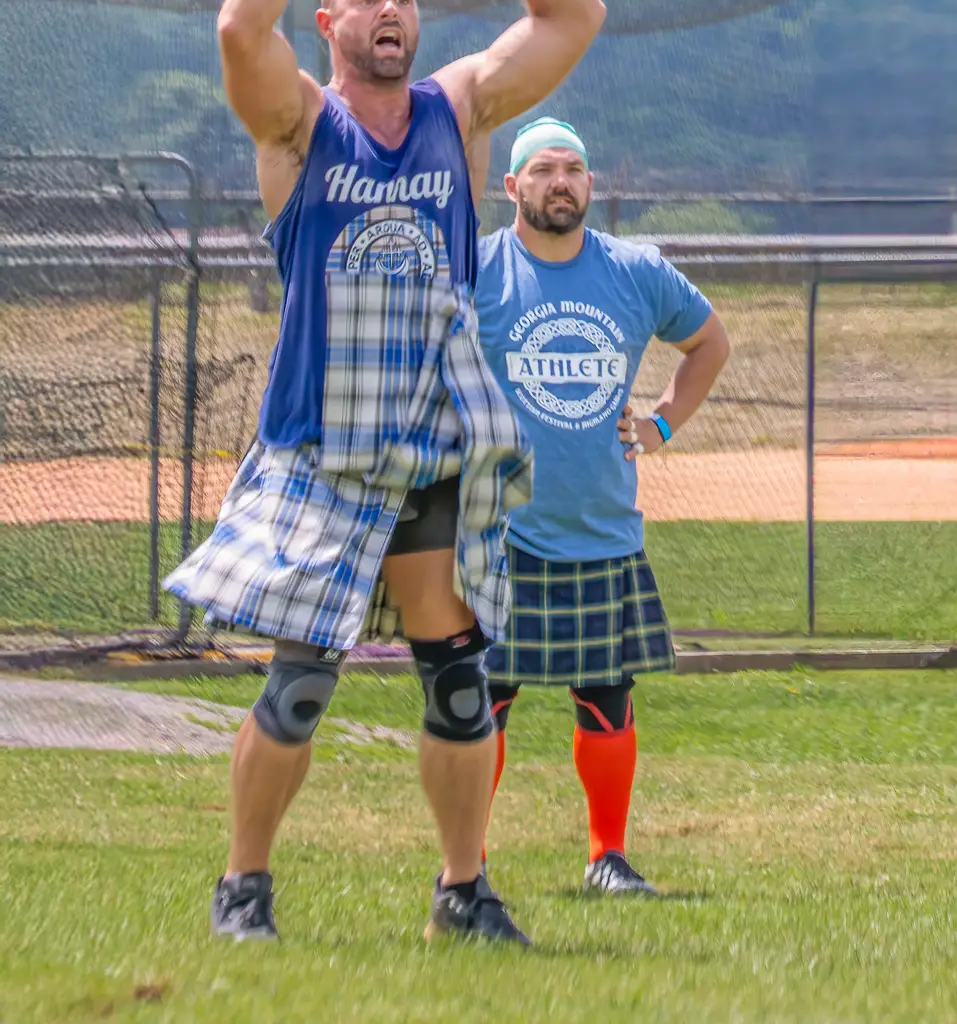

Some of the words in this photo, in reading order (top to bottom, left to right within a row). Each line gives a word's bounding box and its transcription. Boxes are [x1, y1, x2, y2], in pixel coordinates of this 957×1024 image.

[324, 162, 454, 209] Hannay
[347, 246, 362, 270] PER
[412, 235, 427, 251] AD
[508, 302, 558, 342] GEORGIA
[560, 300, 626, 344] MOUNTAIN
[519, 356, 620, 378] ATHLETE
